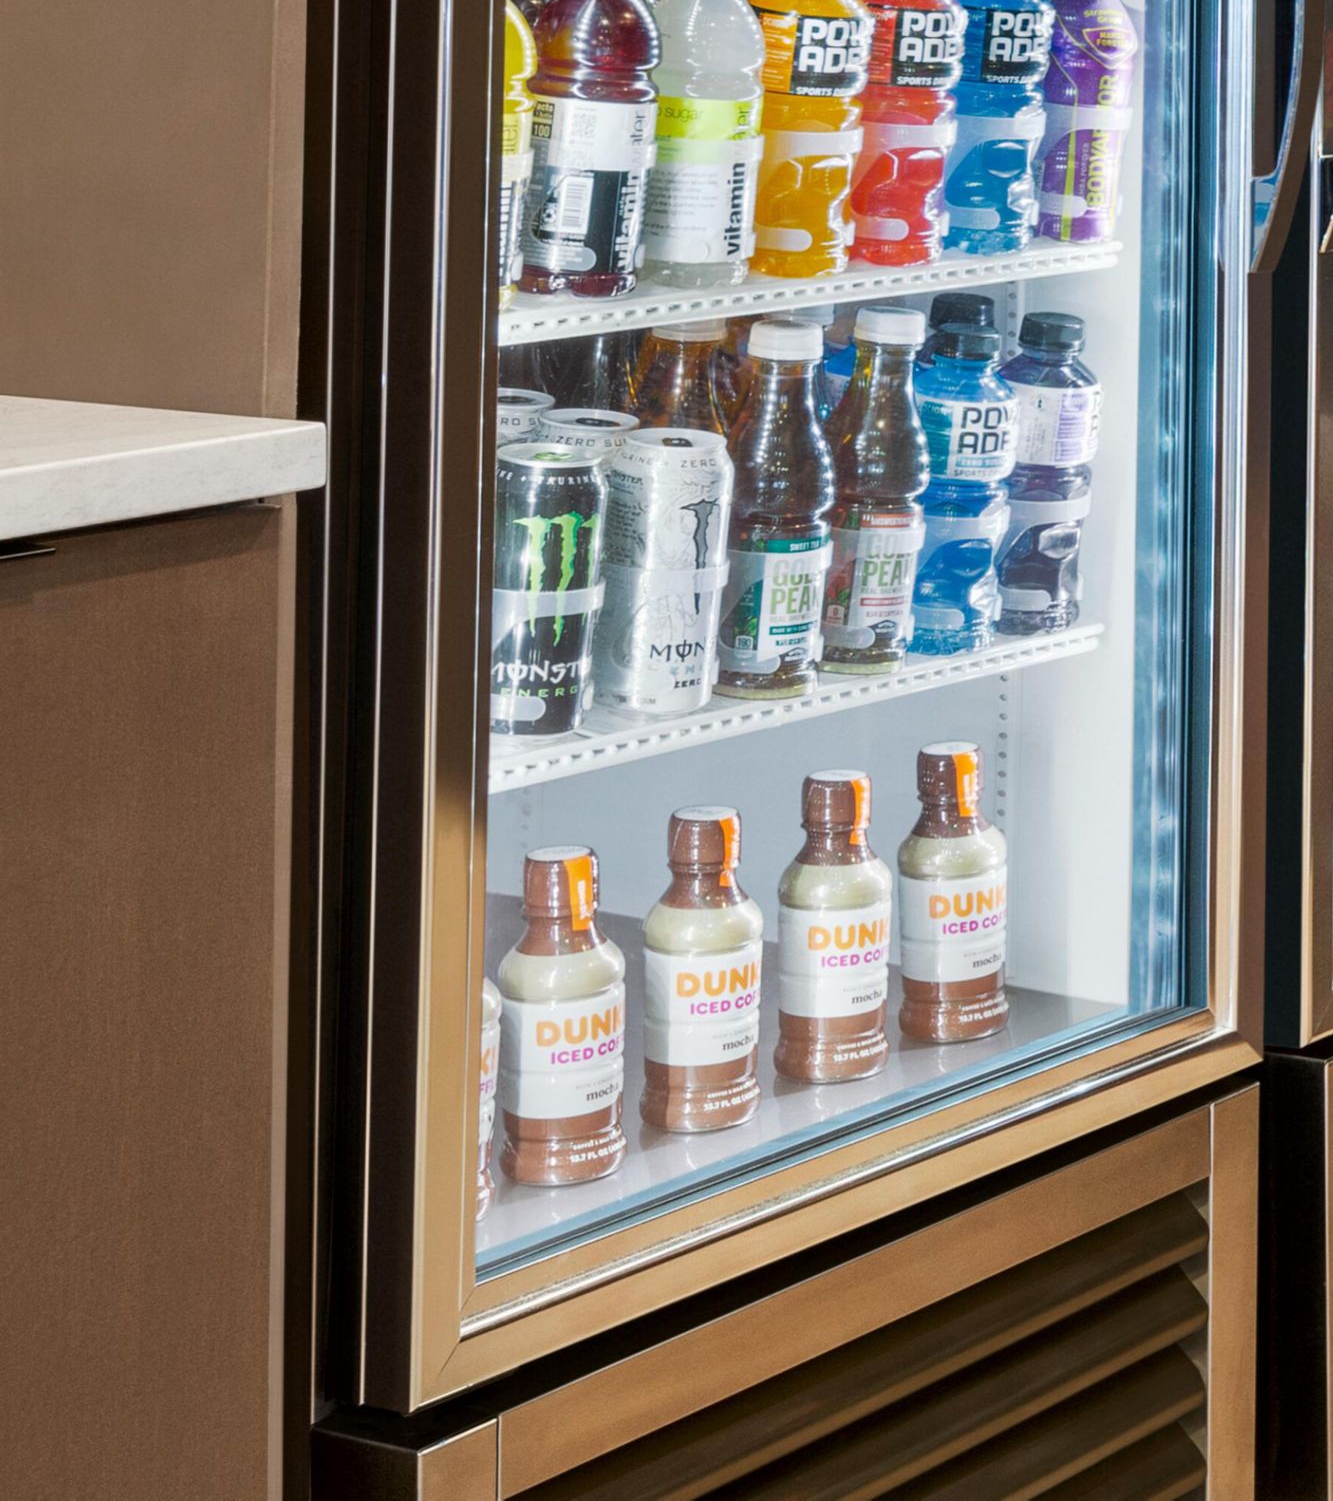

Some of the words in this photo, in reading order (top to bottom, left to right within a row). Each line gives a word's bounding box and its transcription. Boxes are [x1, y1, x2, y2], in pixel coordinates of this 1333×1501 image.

[897, 76, 931, 85] SPORTS
[986, 75, 1019, 84] SPORTS
[796, 87, 832, 96] SPORTS
[533, 123, 551, 137] 100
[555, 435, 596, 447] ZERO
[680, 459, 717, 468] ZERO
[942, 921, 979, 935] ICED
[821, 954, 860, 968] ICED
[972, 953, 1002, 969] mocha
[851, 989, 883, 1004] mocha
[690, 1000, 731, 1015] ICED
[722, 1034, 754, 1052] mocha
[551, 1048, 594, 1065] ICED
[586, 1083, 619, 1102] mocha
